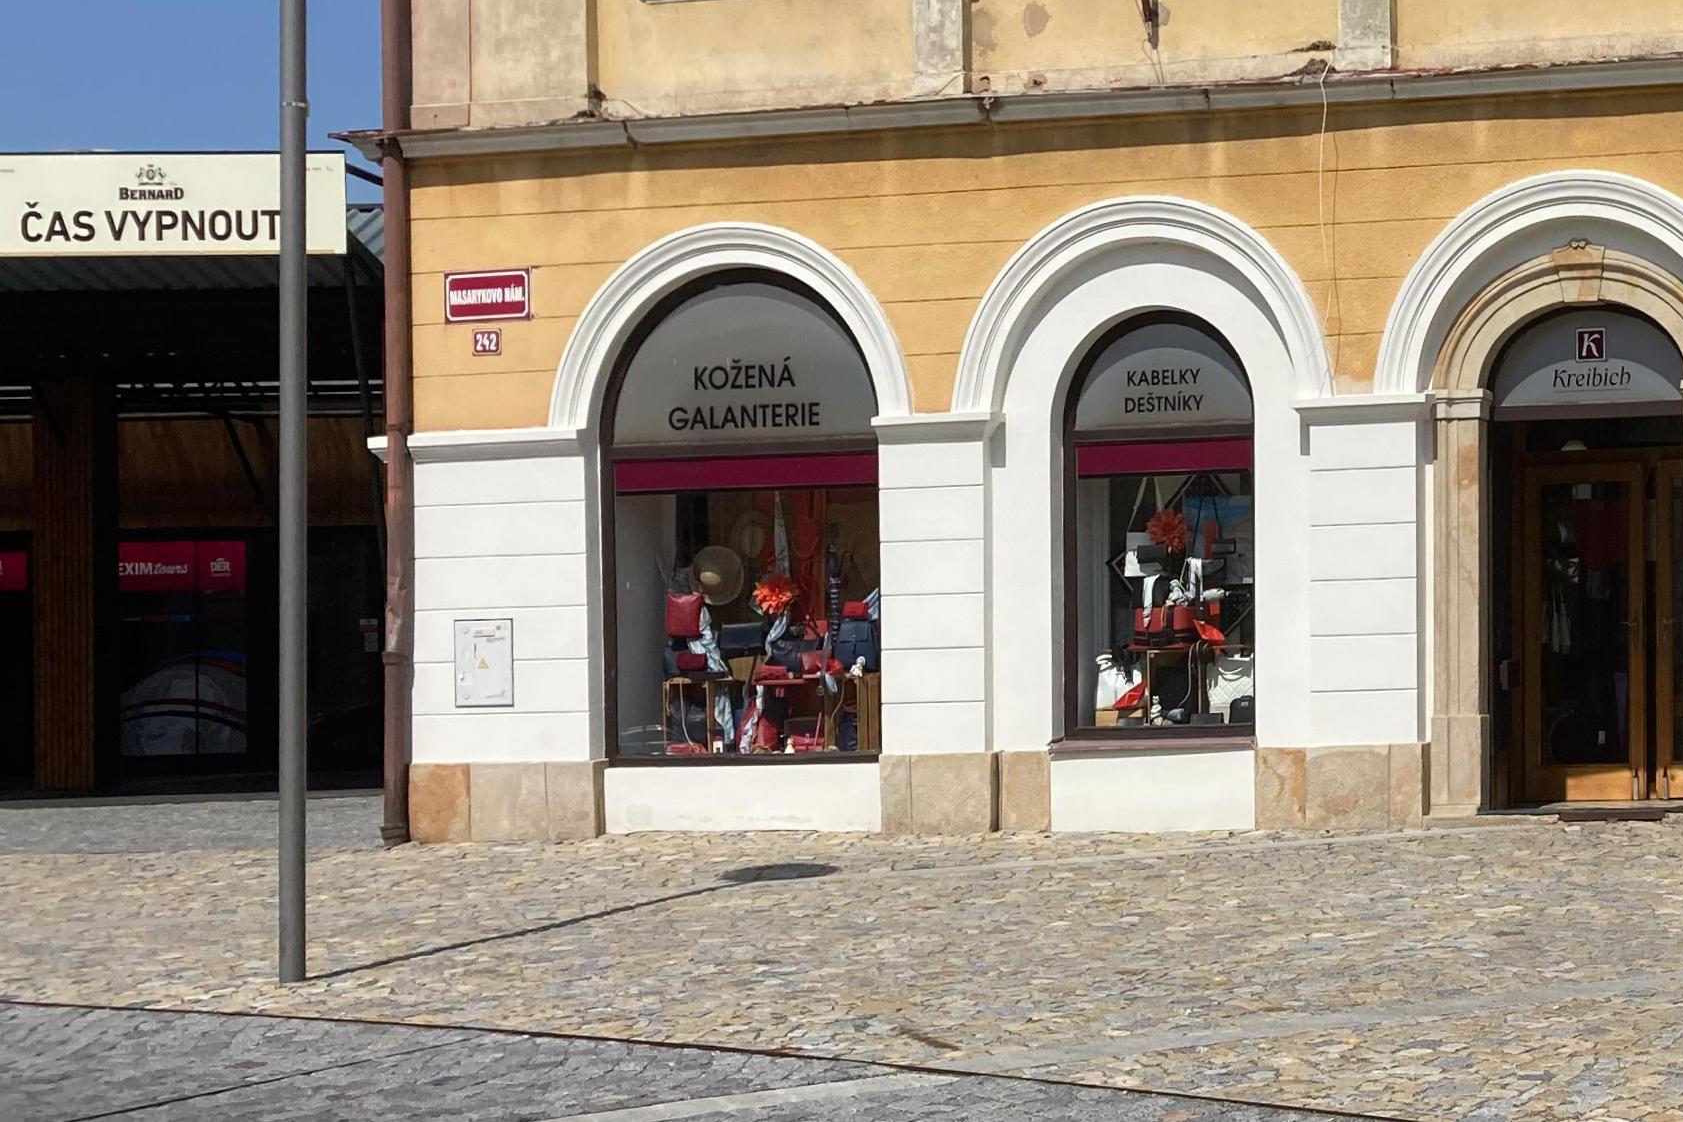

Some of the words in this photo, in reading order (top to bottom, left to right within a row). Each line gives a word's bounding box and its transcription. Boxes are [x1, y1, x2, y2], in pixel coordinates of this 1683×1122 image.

[119, 187, 184, 200] BERNARD
[21, 201, 96, 242] ČAS
[104, 209, 281, 241] VYPNOUT
[450, 287, 502, 305] MASARYKOVO
[504, 283, 525, 302] NÁM.
[476, 333, 497, 350] 242
[1582, 333, 1600, 357] K
[694, 356, 796, 390] KOŽENÁ
[1127, 368, 1200, 386] KABELKY
[1553, 366, 1631, 388] Kreibich
[1124, 391, 1203, 413] DEŠTNÍKY
[668, 402, 820, 431] GALANTERIE
